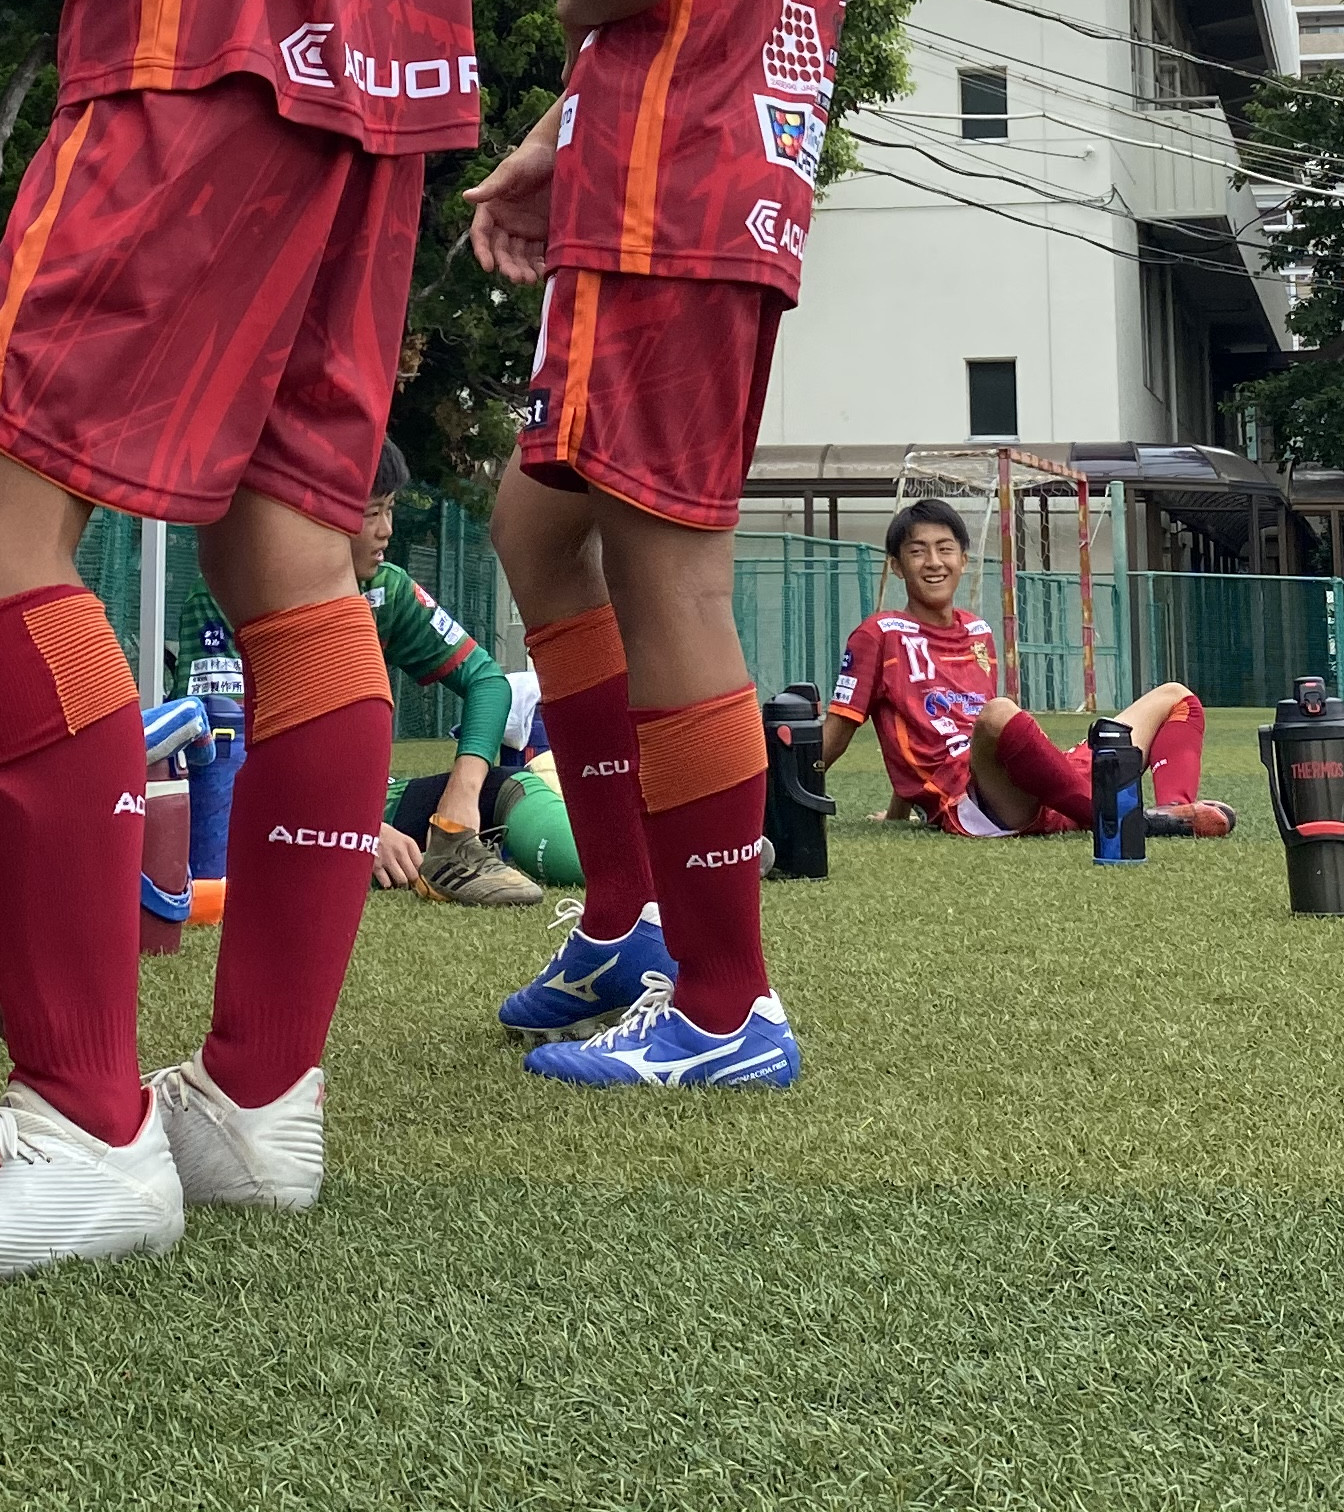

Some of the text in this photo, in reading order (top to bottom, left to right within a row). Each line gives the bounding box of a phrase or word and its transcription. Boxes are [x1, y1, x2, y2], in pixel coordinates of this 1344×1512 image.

[344, 41, 479, 100] ACUOR
[901, 634, 936, 684] 17
[581, 758, 630, 779] ACU
[1290, 761, 1344, 779] THERMOS
[685, 835, 763, 869] ACUOR
